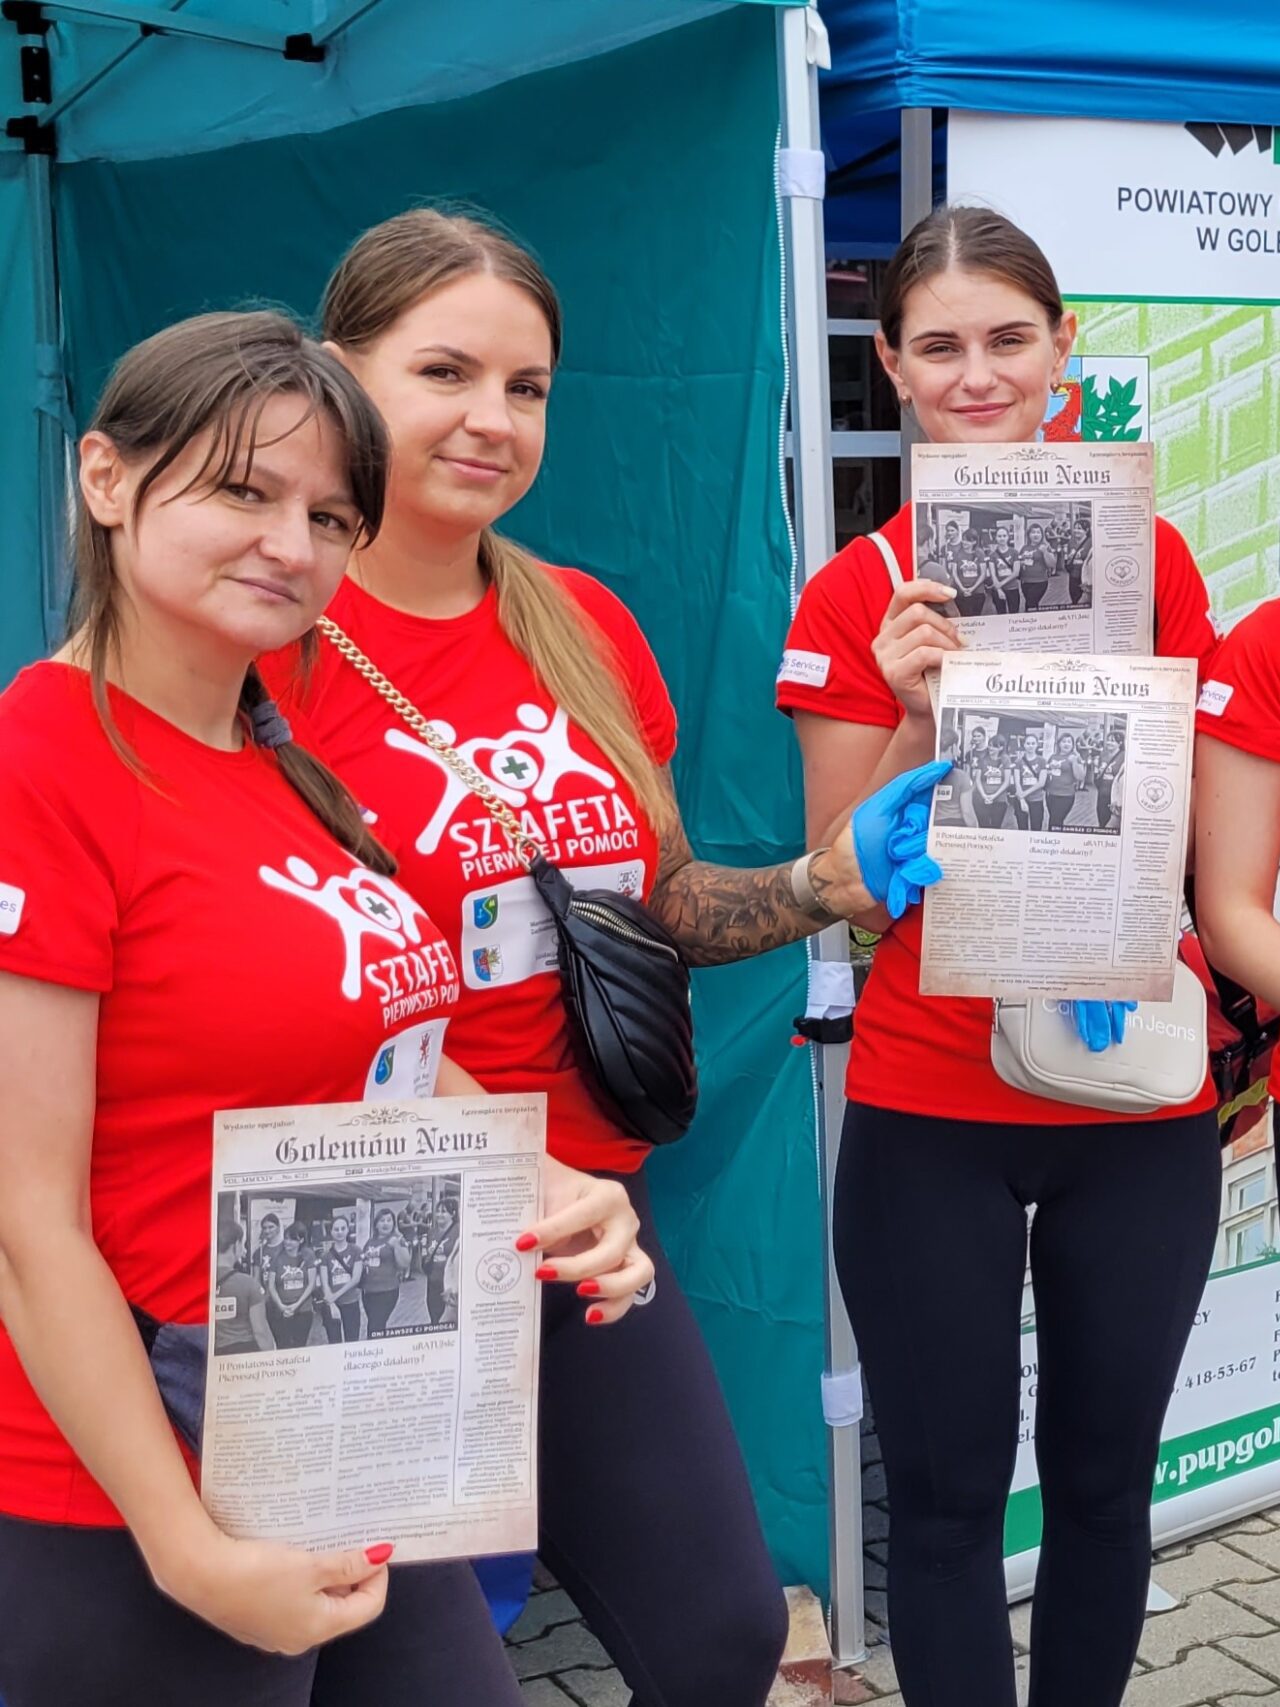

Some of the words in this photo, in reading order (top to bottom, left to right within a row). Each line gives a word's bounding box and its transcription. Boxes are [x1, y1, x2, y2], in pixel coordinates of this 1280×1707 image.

[1117, 187, 1273, 218] POWIATOWY
[1196, 227, 1220, 251] W
[954, 463, 1050, 487] Goleniów
[1055, 464, 1112, 485] News
[790, 658, 826, 673] Services
[985, 673, 1086, 696] Goleniów
[1092, 674, 1150, 698] News
[566, 828, 639, 859] POMOCY
[364, 938, 459, 1004] SZTAFE
[382, 990, 438, 1029] PIERWSZEJ
[1145, 1014, 1196, 1041] Jeans
[275, 1131, 407, 1165] Goleniów
[415, 1126, 489, 1155] News
[343, 1360, 382, 1371] dlaczego
[344, 1347, 384, 1359] Fundacja
[1184, 1356, 1256, 1389] 418-53-67
